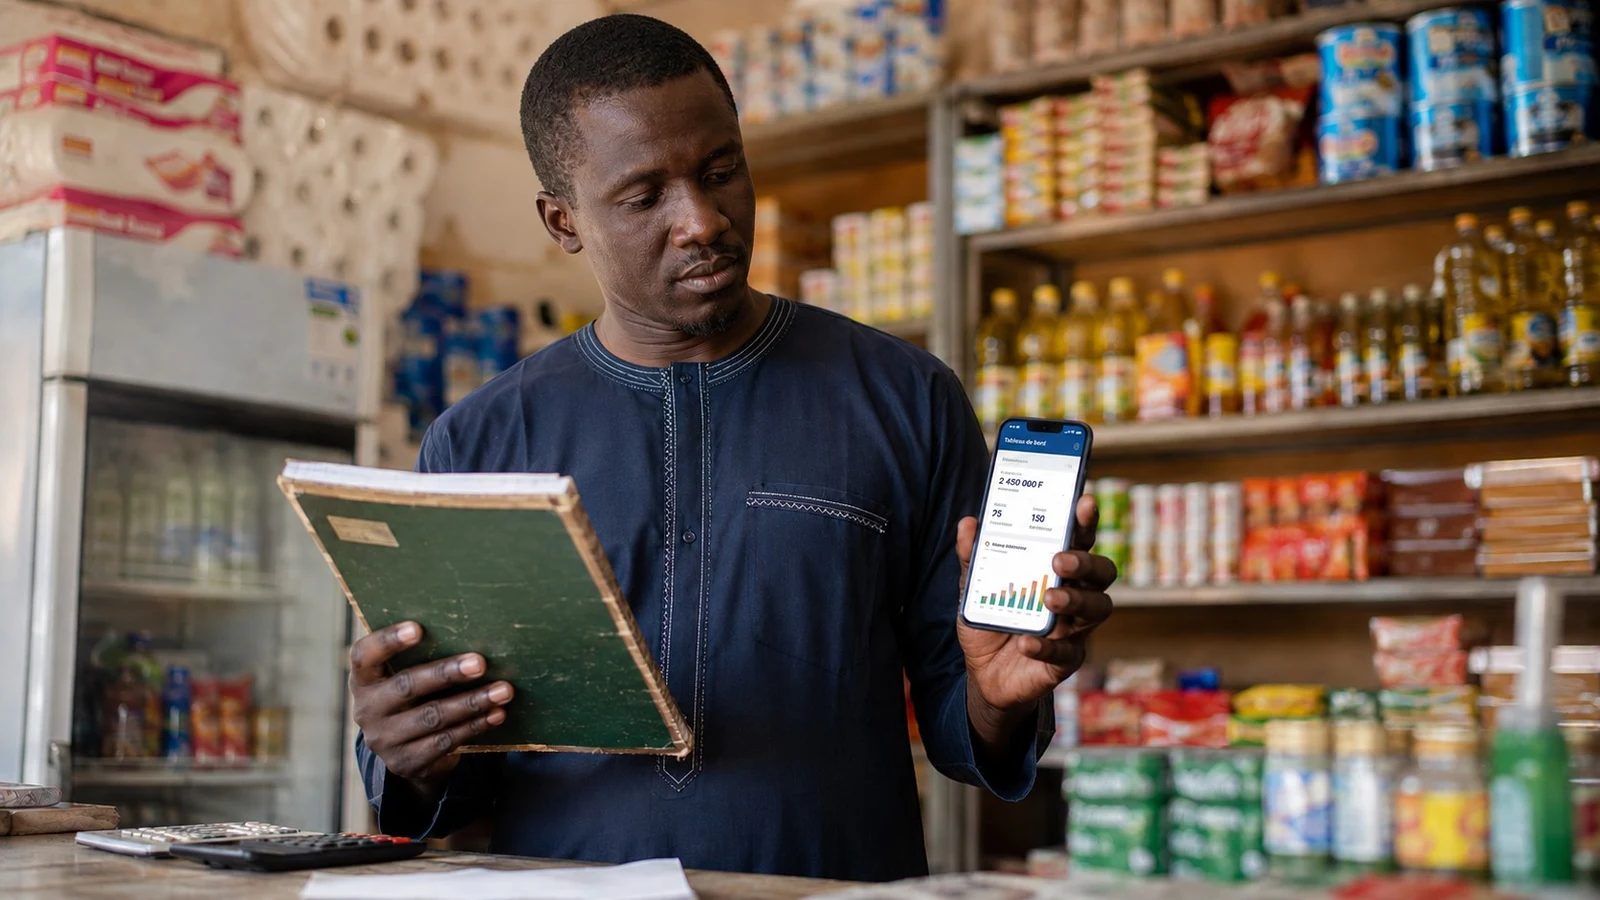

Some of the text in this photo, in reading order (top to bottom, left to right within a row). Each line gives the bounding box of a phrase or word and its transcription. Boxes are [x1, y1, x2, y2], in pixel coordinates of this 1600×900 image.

[999, 477, 1005, 485] 2
[1006, 478, 1021, 486] 450
[1022, 479, 1037, 488] 000
[1032, 513, 1045, 523] 150
